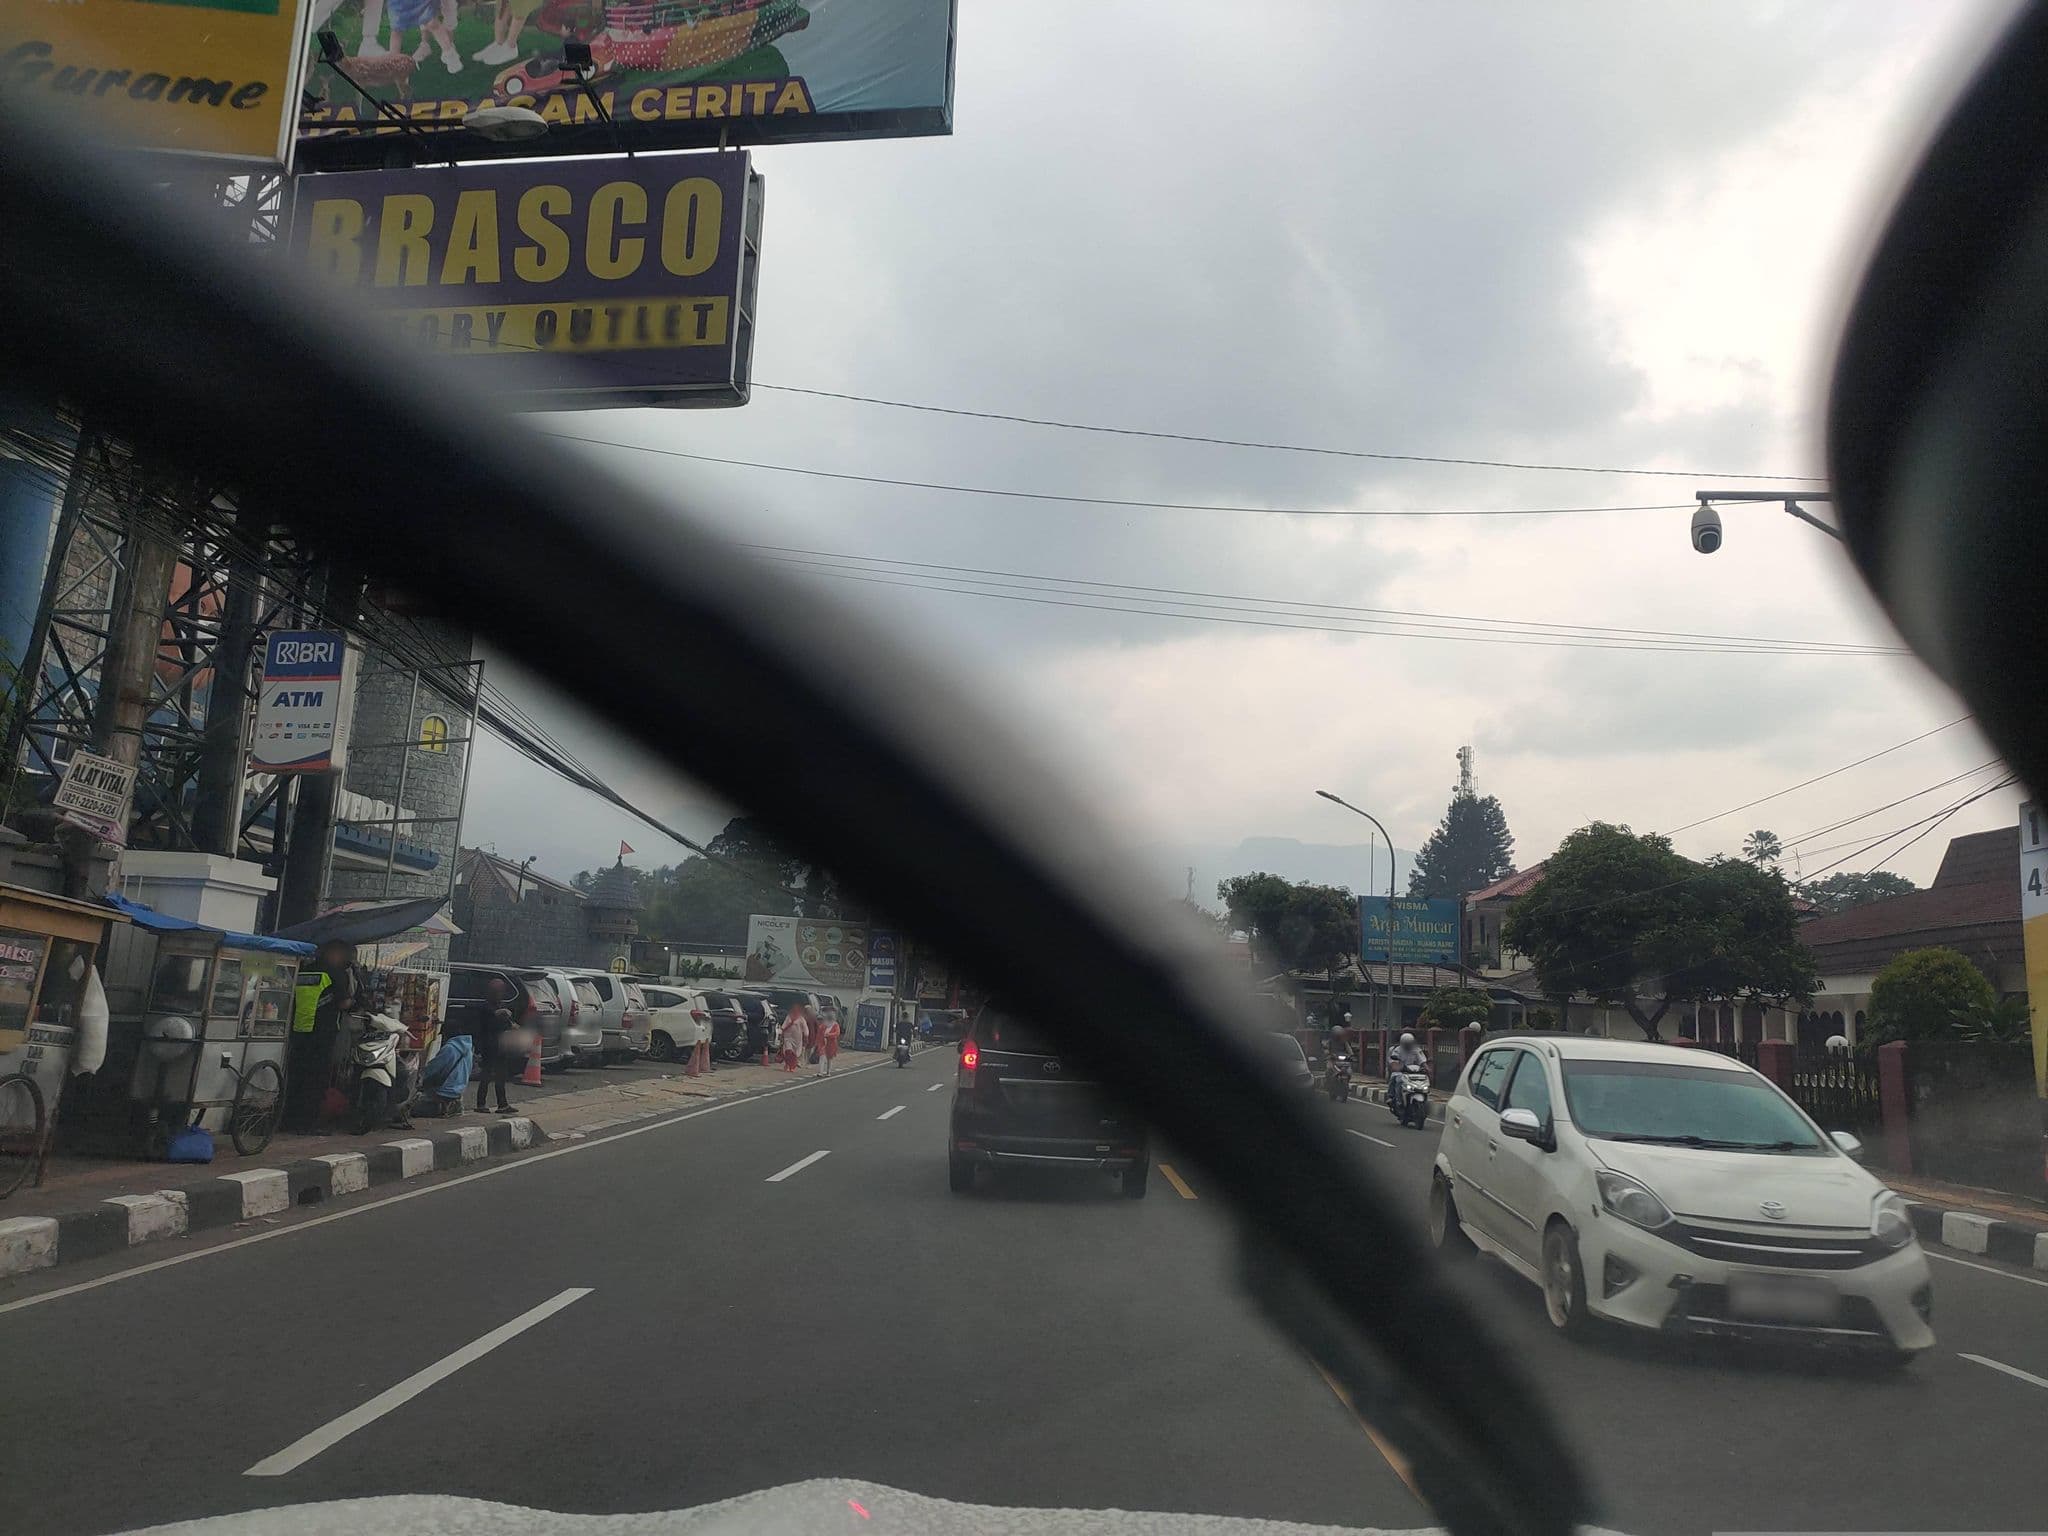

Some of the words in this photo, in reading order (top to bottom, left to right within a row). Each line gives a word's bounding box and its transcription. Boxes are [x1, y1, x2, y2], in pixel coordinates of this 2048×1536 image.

[6, 40, 269, 110] Gurame
[630, 80, 810, 120] CERITA
[308, 176, 724, 289] BRASCO
[533, 302, 715, 347] OUTLET
[299, 641, 336, 663] BRI
[271, 691, 324, 708] ATM
[70, 763, 101, 786] ALAT
[97, 770, 127, 795] VITAL
[1392, 901, 1429, 911] WISMA
[1369, 914, 1401, 937] Arga
[1404, 914, 1455, 934] Muncar
